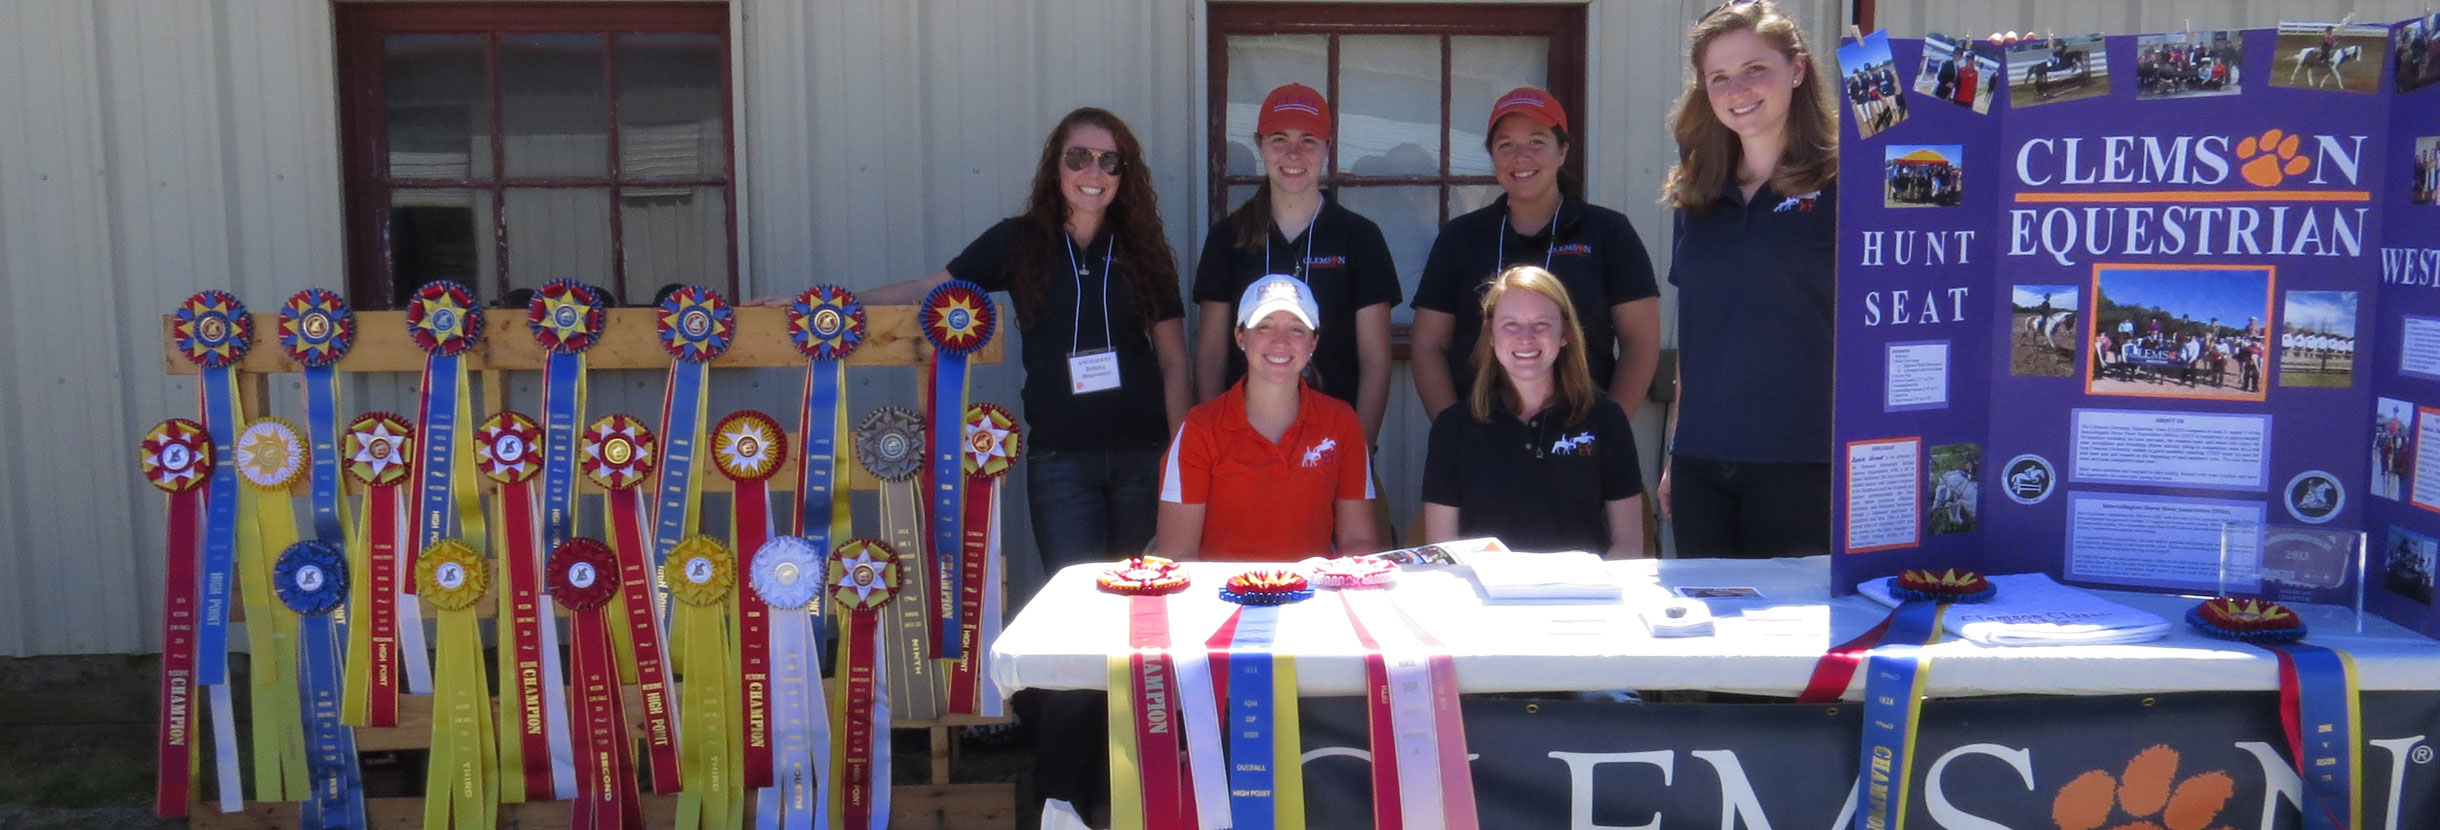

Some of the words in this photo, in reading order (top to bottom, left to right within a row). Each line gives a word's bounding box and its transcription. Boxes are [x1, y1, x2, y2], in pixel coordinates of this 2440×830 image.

[2016, 130, 2368, 186] CLEMSN
[1861, 230, 1975, 266] HUNT
[2007, 205, 2368, 266] EQUESTRIAN
[1865, 287, 1968, 326] SEAT
[941, 553, 953, 619] CHAMPION
[203, 599, 222, 627] POINT
[912, 639, 922, 676] NINTH
[169, 677, 187, 746] CHAMPION
[522, 669, 541, 734] CHAMPION
[646, 692, 663, 715] HIGH
[749, 682, 765, 748] CHAMPION
[463, 762, 473, 798] THIRD
[600, 752, 612, 801] SECOND
